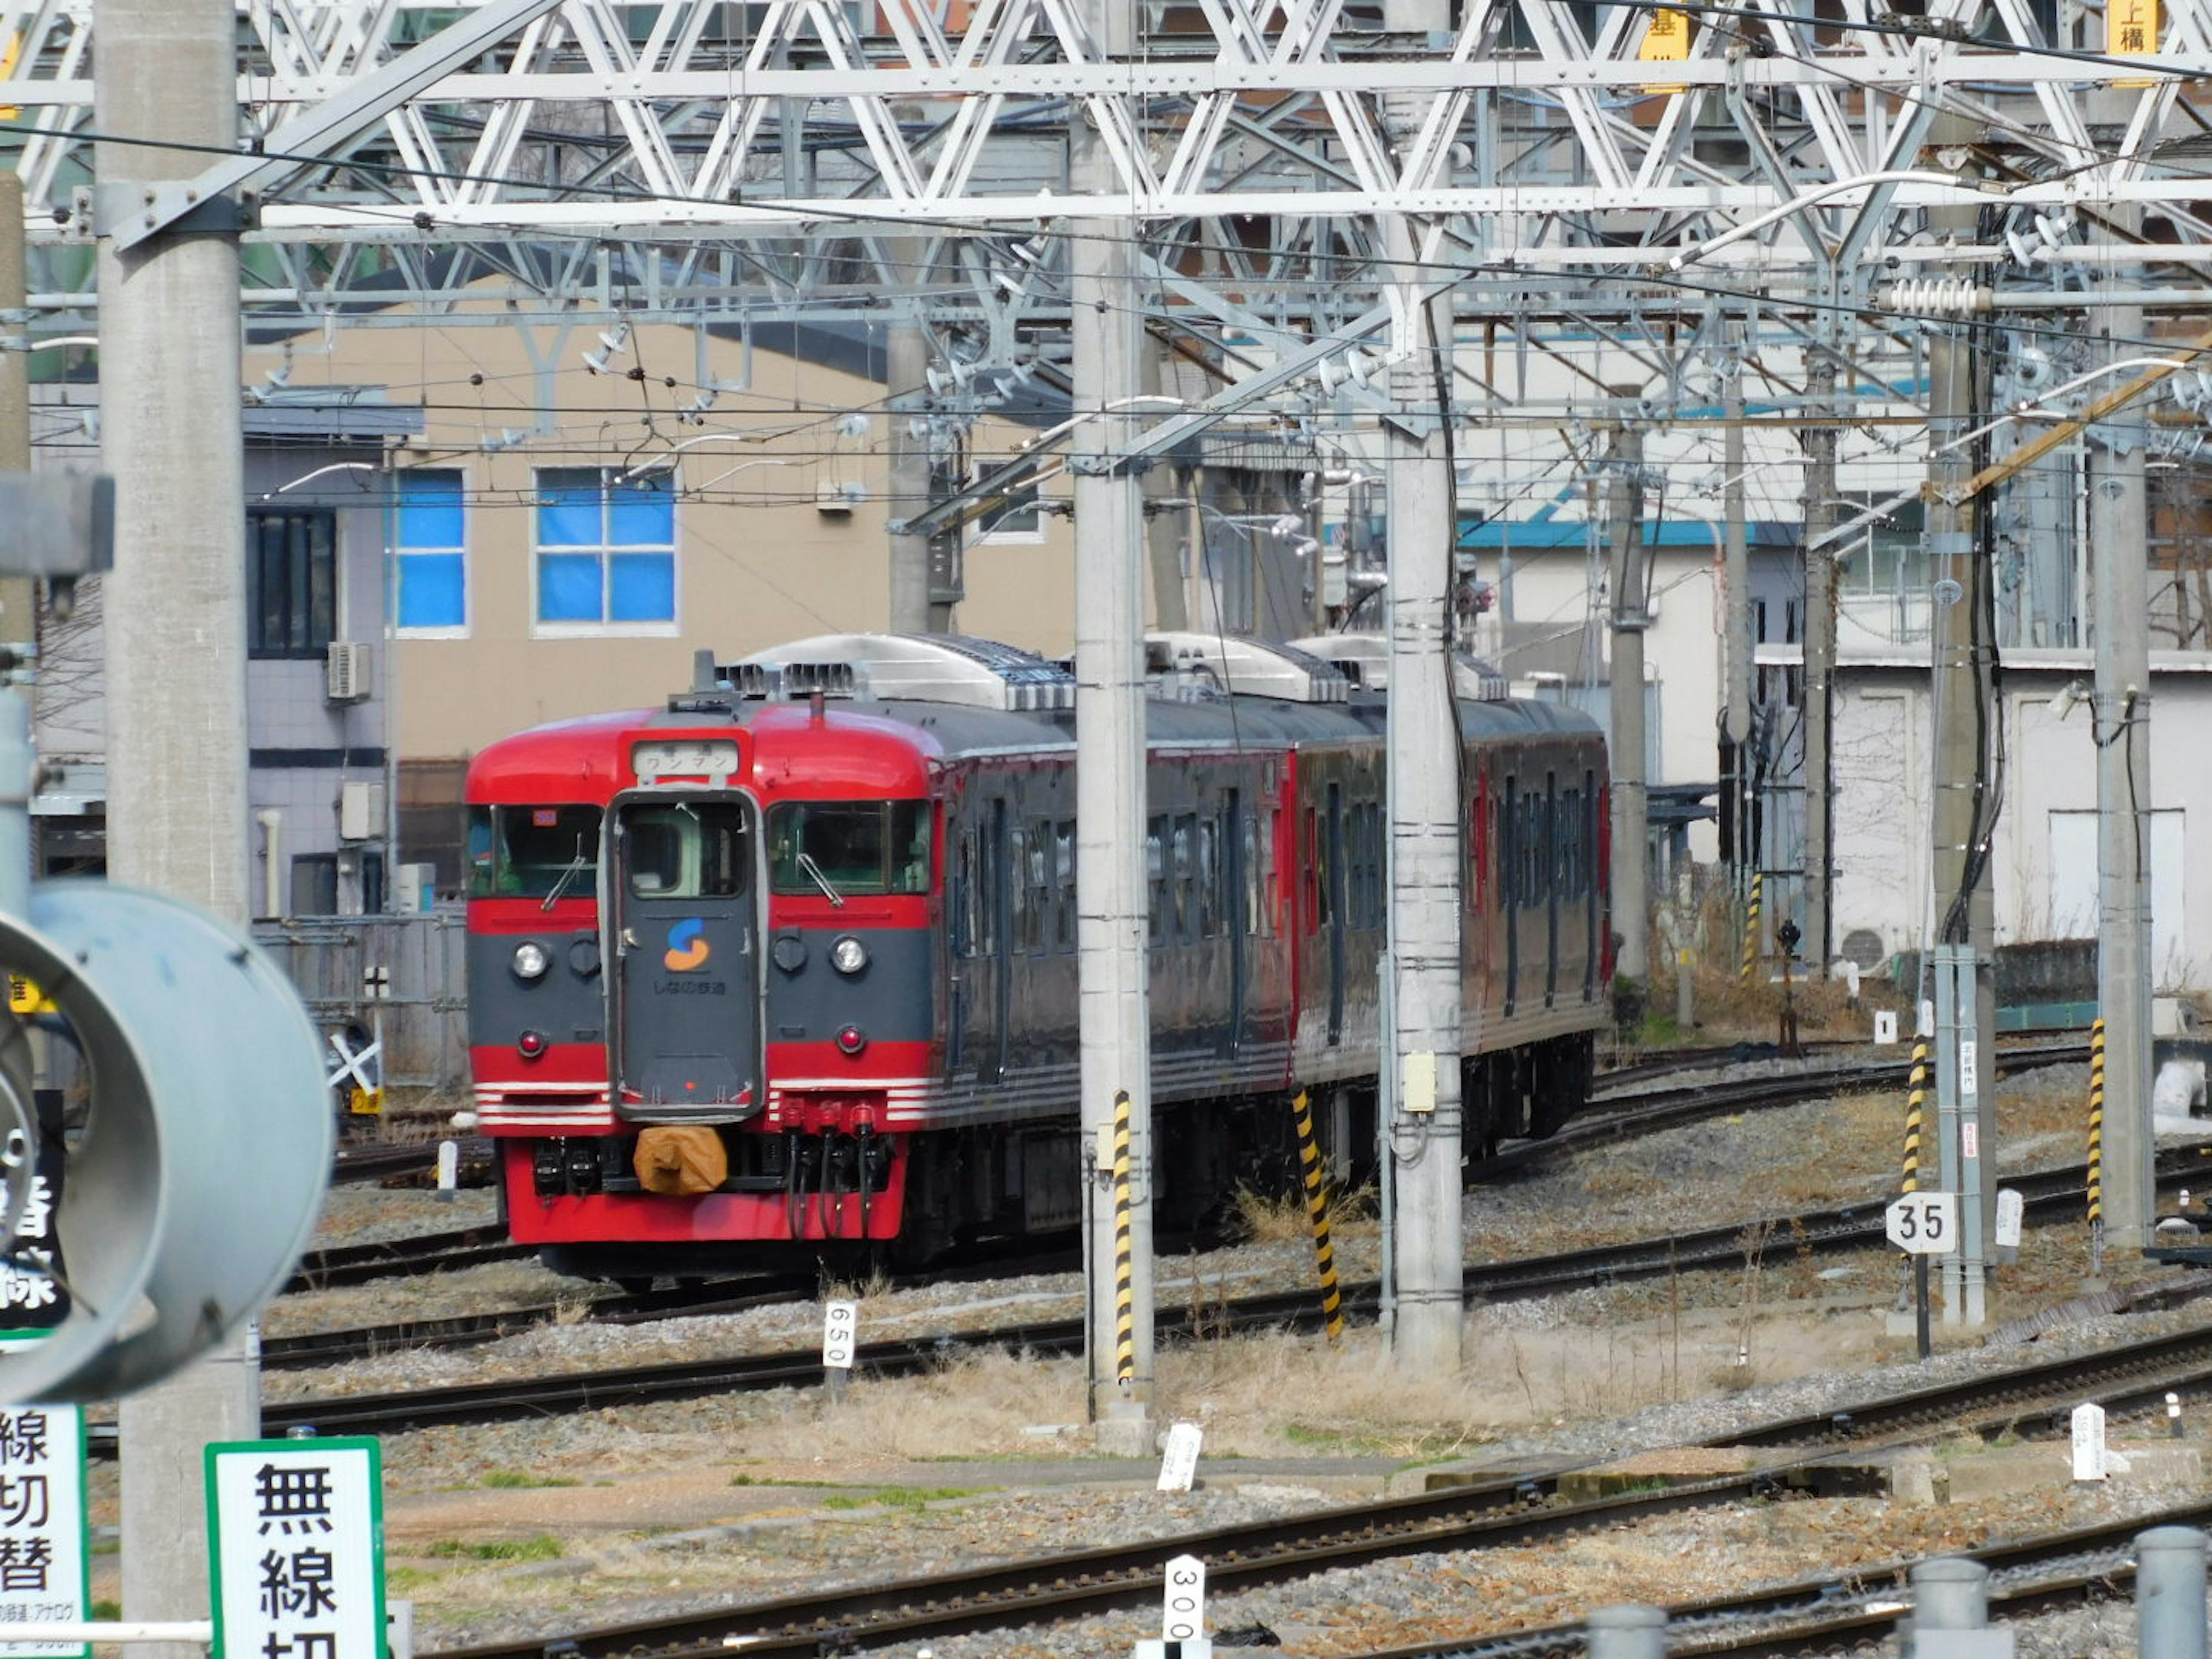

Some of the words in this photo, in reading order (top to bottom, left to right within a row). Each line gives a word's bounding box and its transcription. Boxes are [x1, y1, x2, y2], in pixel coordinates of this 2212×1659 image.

[647, 757, 726, 770] ワンマン
[654, 981, 725, 995] しなの鉄道
[1880, 1020, 1887, 1034] 1
[1899, 1205, 1942, 1239] 35
[828, 1308, 850, 1361] 650
[1171, 1571, 1197, 1638] 300
